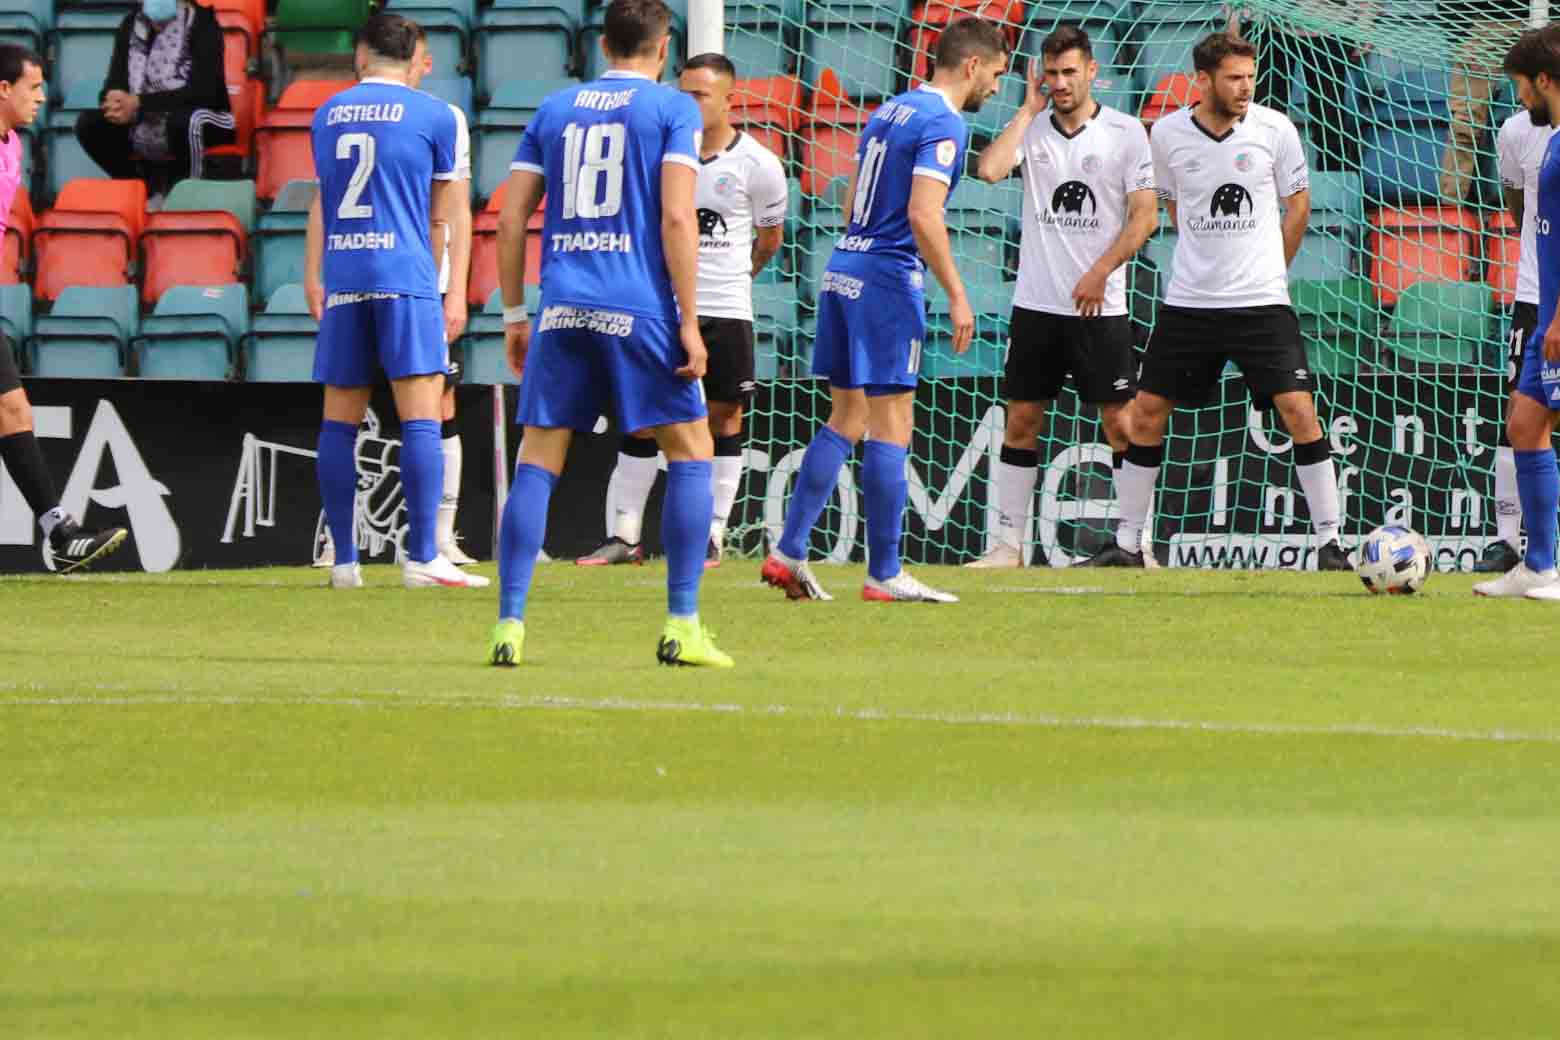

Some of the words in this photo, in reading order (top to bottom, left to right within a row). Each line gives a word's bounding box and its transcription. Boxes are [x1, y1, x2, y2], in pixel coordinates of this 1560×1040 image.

[326, 102, 405, 126] CASTIELLO
[334, 132, 376, 220] 2
[562, 122, 626, 220] 18
[1186, 214, 1257, 233] Salamanca
[327, 231, 396, 251] TRADEHI
[551, 232, 632, 253] TRADEHI
